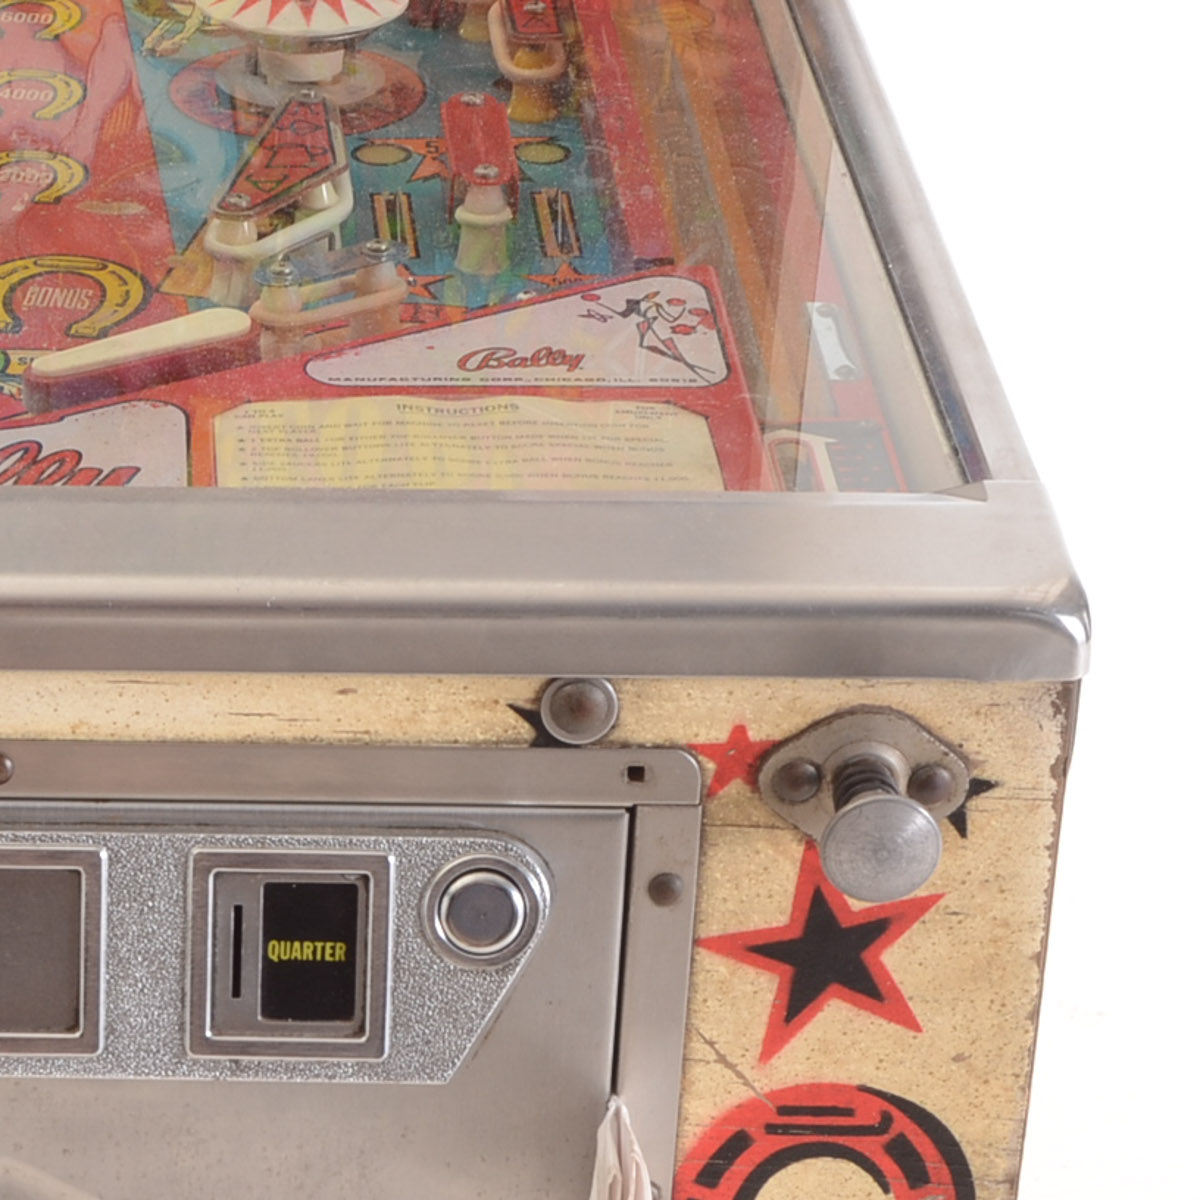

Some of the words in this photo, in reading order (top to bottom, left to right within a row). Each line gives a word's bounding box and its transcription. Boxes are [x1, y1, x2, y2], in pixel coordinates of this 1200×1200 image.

[0, 11, 54, 26] 6000
[21, 286, 95, 310] BONUS
[457, 346, 586, 373] Bally
[396, 403, 520, 415] INSTRUCTIONS
[267, 940, 347, 963] QUARTER
